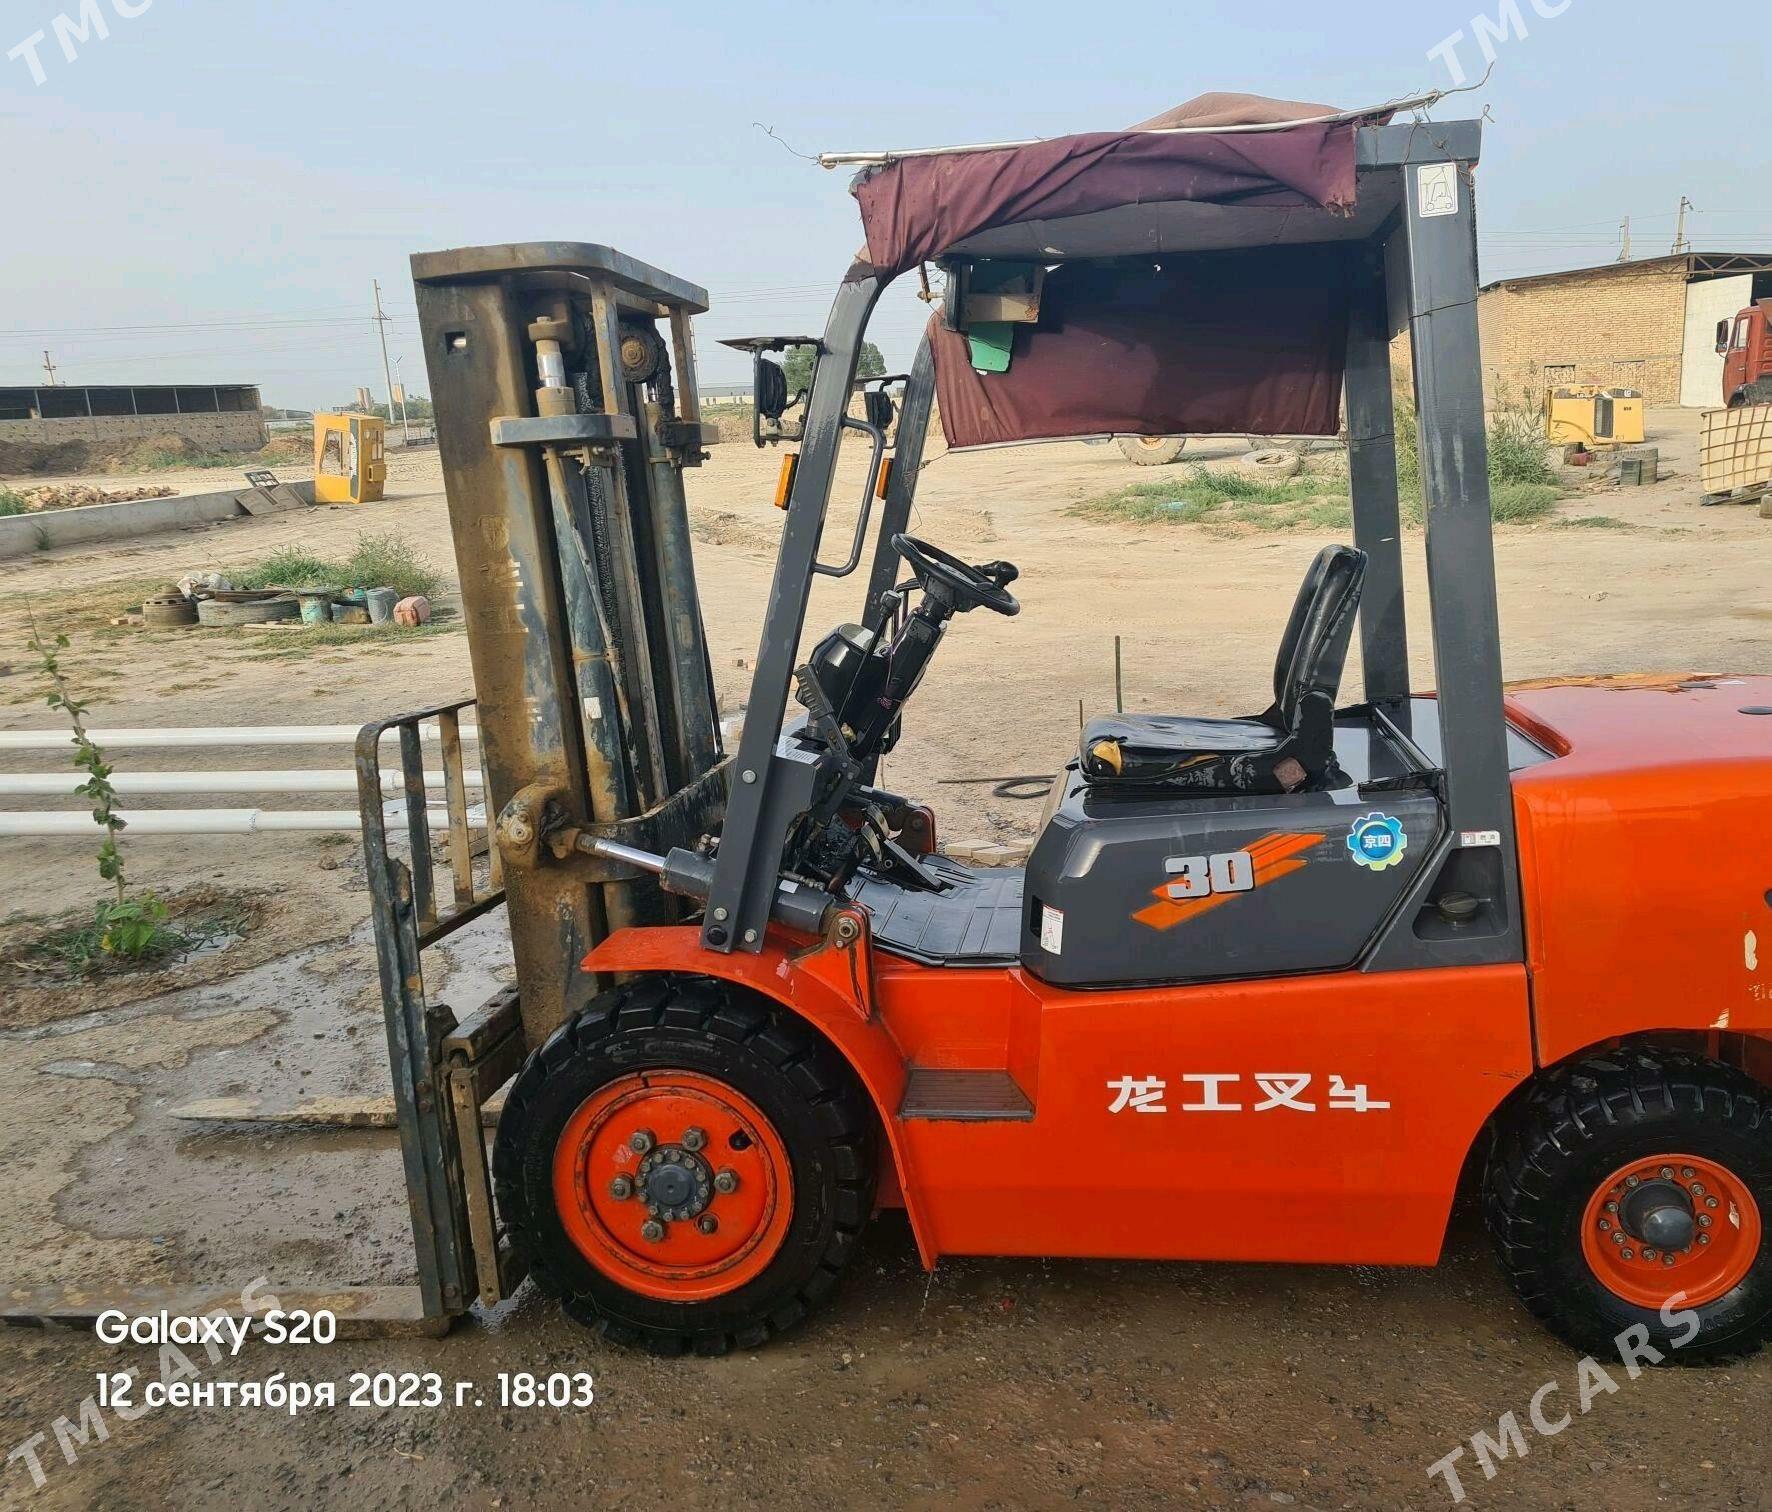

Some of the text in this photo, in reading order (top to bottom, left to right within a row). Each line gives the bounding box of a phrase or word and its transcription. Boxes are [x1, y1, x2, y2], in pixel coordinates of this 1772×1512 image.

[1164, 851, 1255, 900] 30
[1106, 1073, 1391, 1114] 龙工叉车
